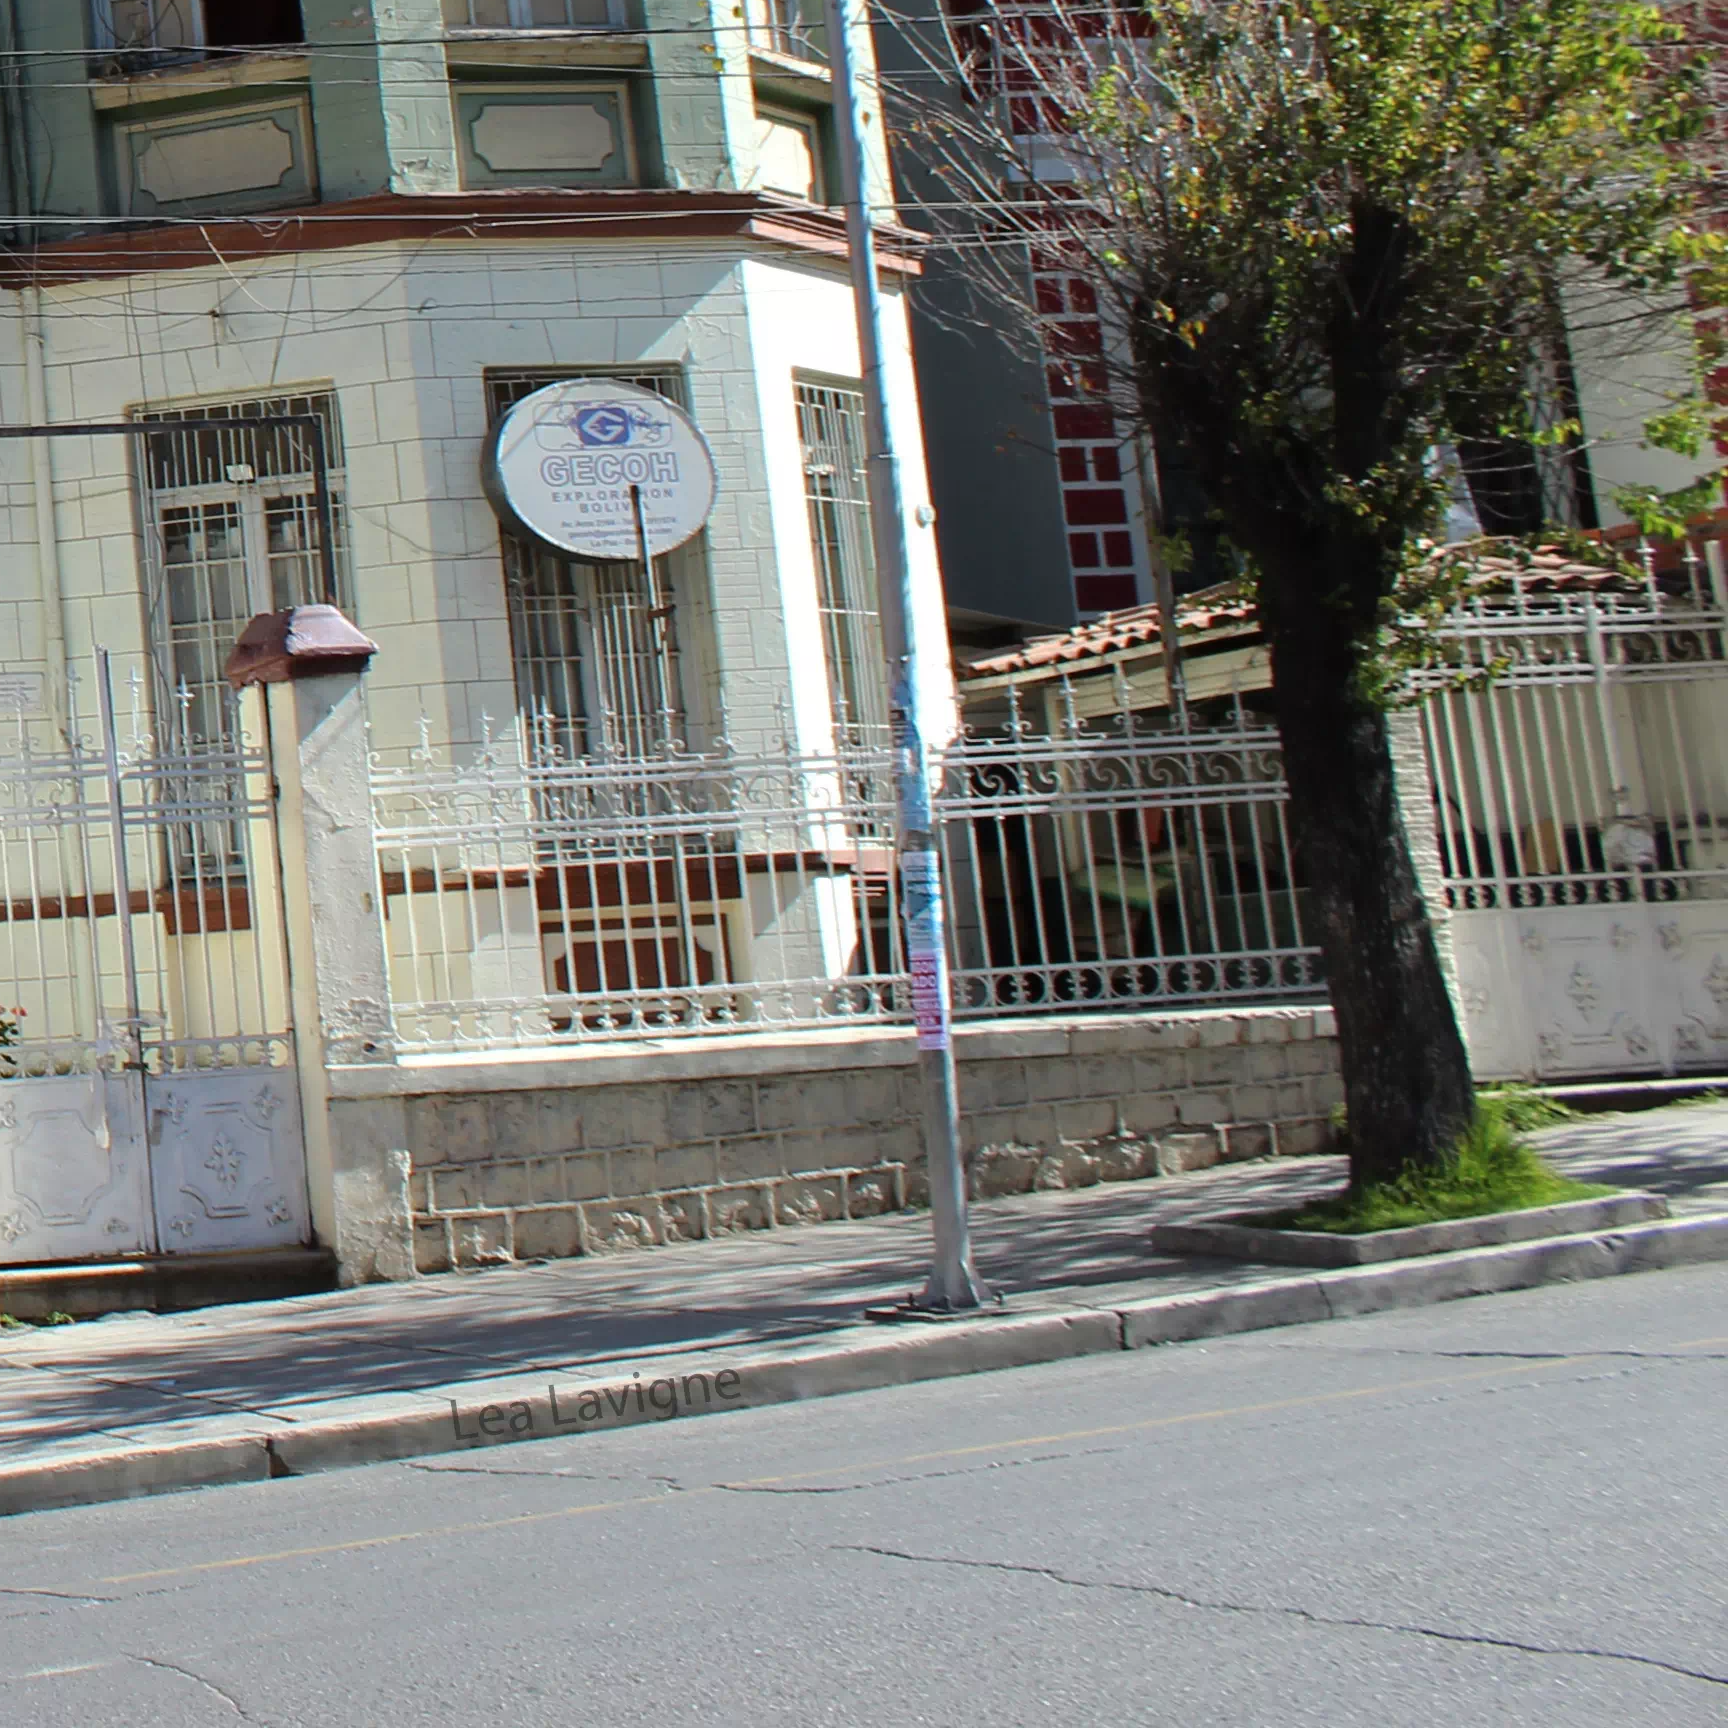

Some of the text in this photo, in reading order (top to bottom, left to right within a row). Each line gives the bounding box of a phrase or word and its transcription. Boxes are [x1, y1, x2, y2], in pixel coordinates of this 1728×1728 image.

[539, 451, 680, 488] GECOH
[550, 488, 674, 503] EXPLORAION
[579, 501, 651, 514] BOLIVA
